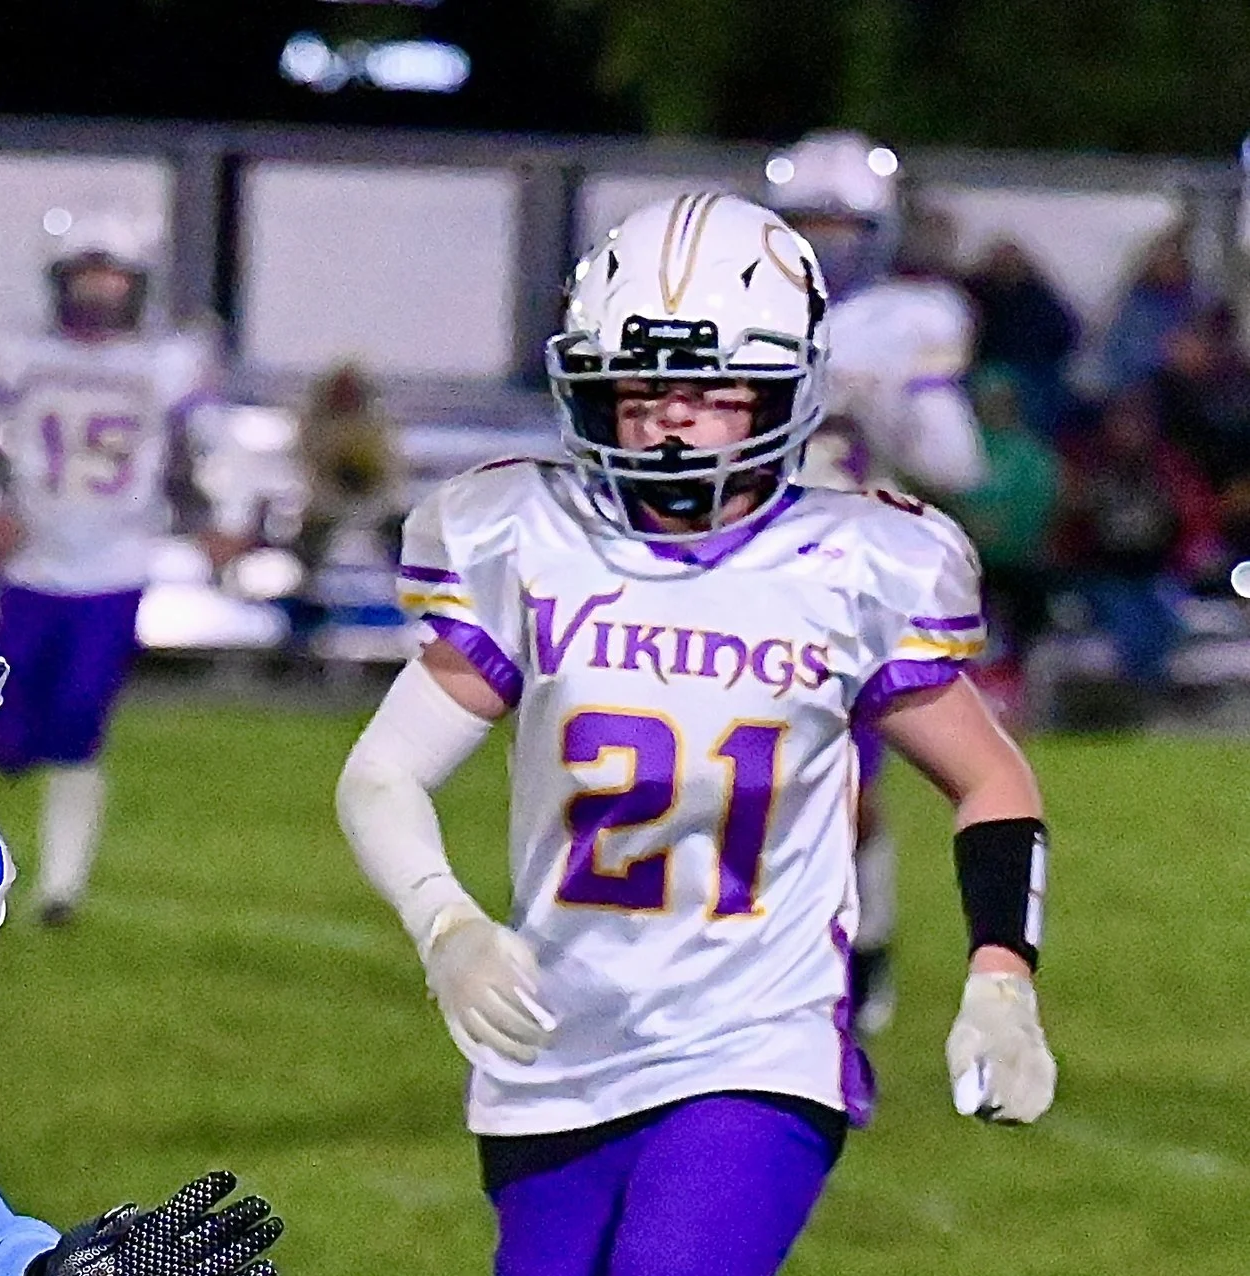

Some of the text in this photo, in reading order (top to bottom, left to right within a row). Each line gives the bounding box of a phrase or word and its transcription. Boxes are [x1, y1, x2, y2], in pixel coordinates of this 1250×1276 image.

[40, 411, 143, 495] 15
[519, 580, 831, 698] VIKINGS
[556, 704, 792, 921] 21
